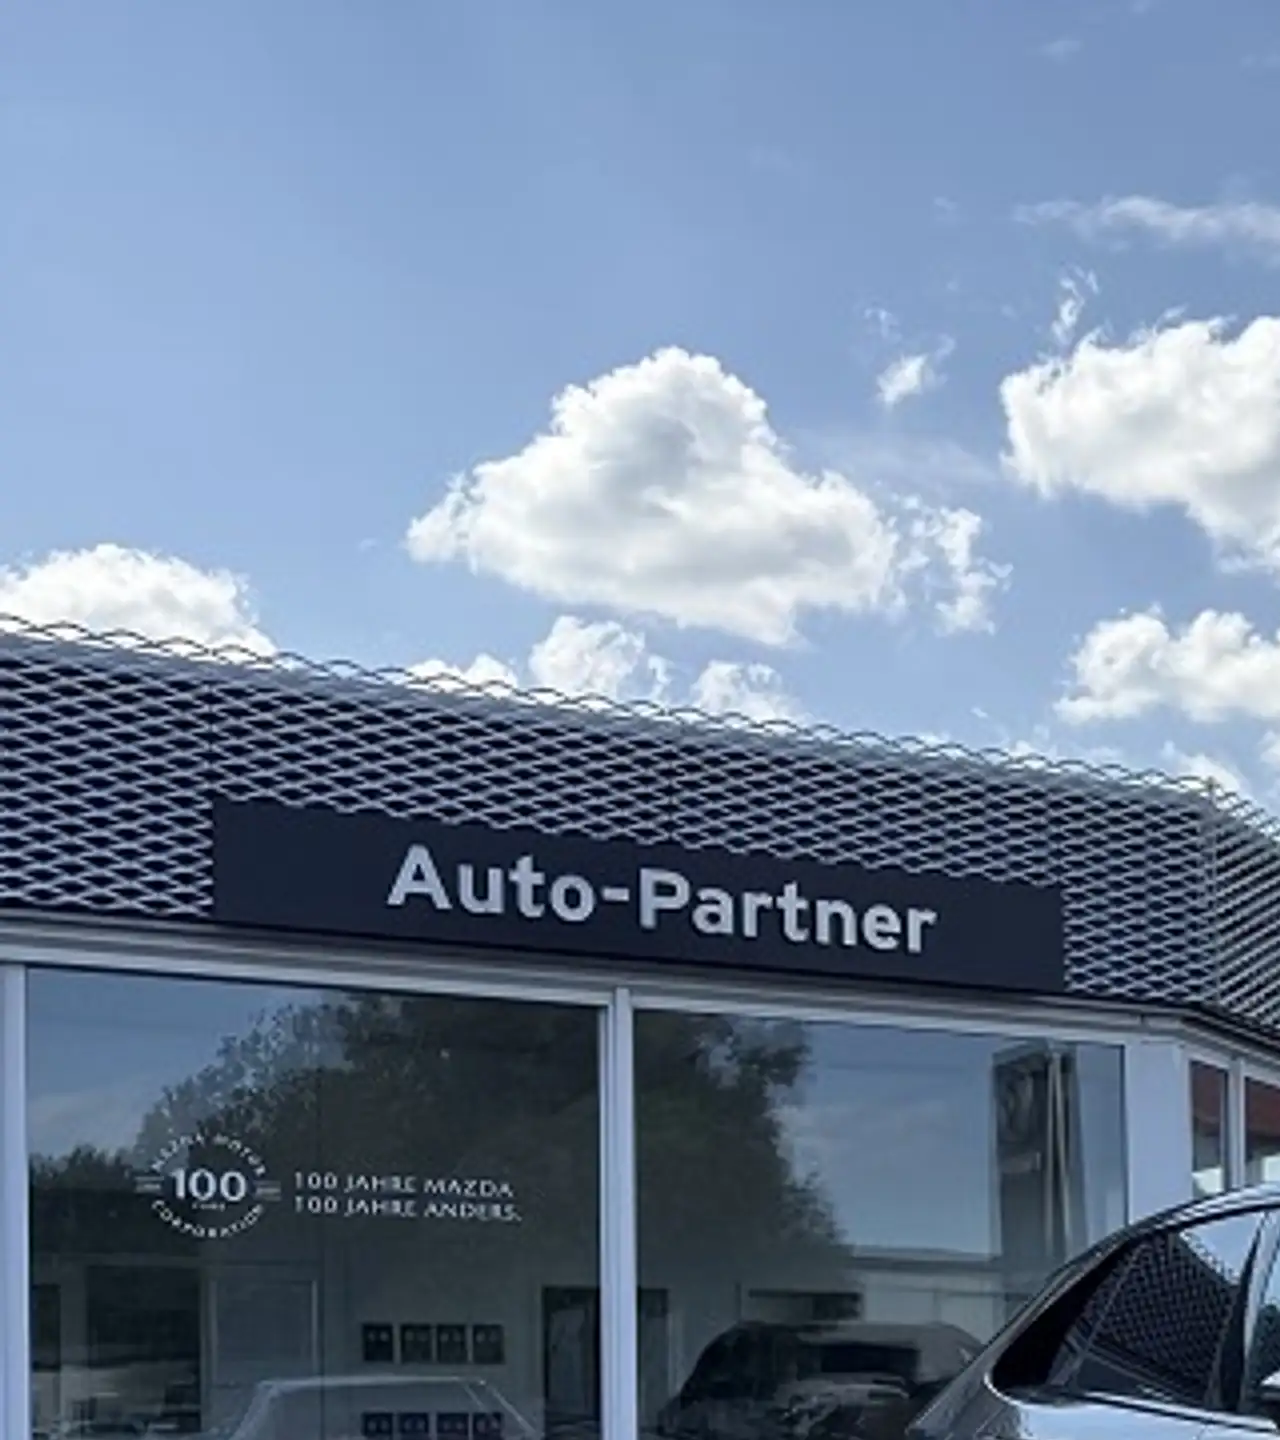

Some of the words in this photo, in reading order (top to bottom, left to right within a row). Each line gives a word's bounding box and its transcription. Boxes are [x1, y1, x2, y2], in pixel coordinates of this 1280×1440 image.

[387, 844, 938, 954] Auto-Partner
[170, 1167, 248, 1203] 100
[294, 1171, 338, 1191] 100
[344, 1173, 417, 1193] JAHRE
[294, 1195, 338, 1214] 100
[344, 1197, 417, 1217] JAHRE
